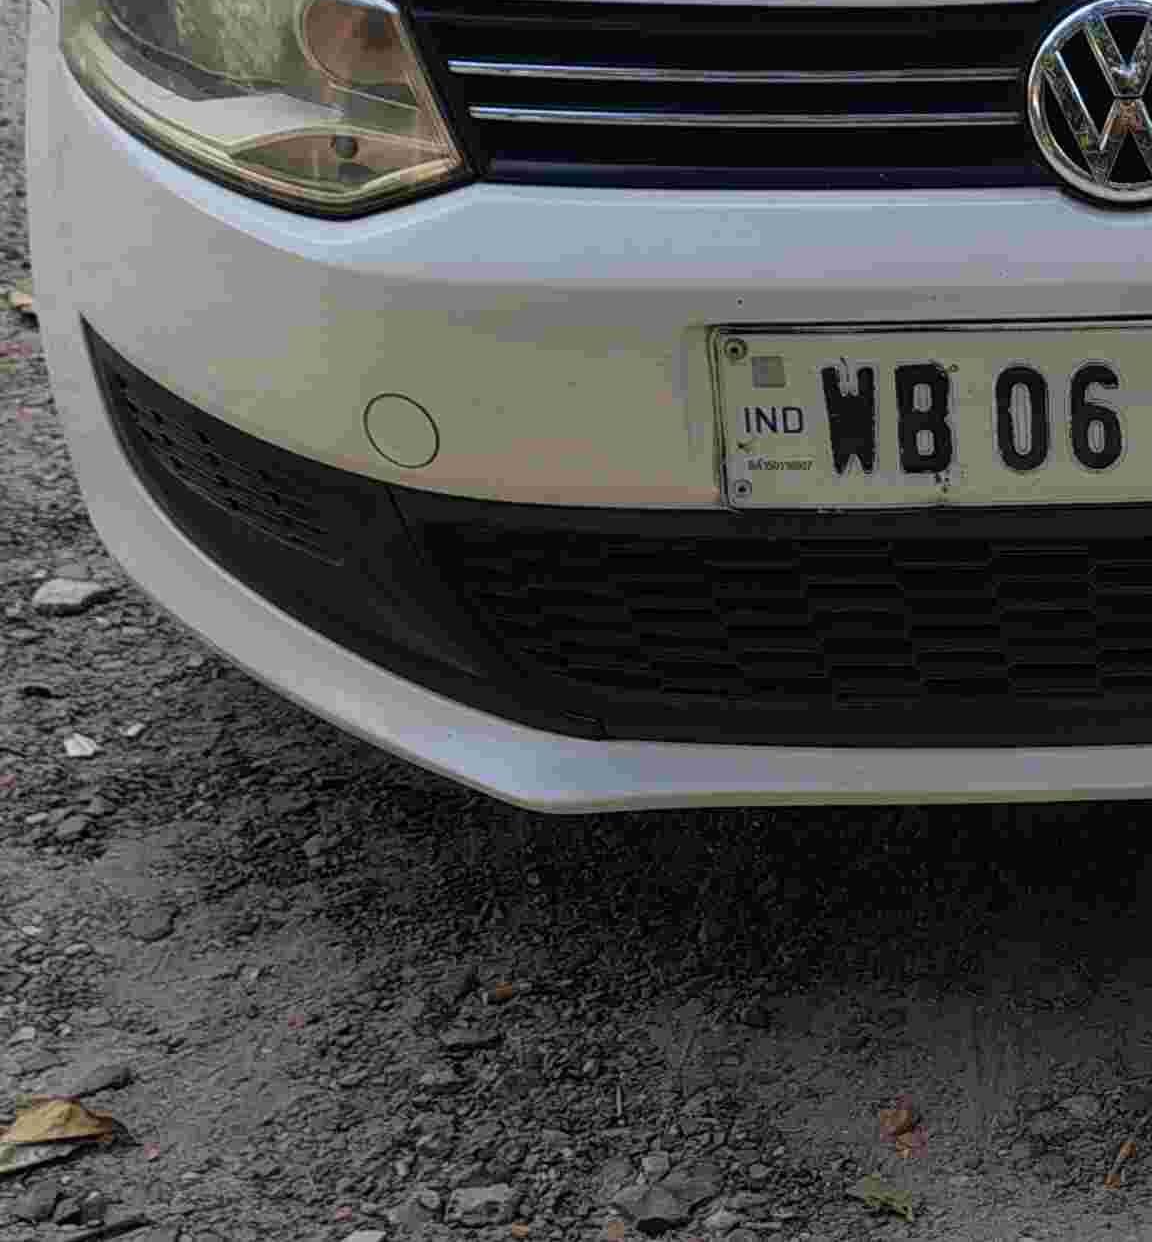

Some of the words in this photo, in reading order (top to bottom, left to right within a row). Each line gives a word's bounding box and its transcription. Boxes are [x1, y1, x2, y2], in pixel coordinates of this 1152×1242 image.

[743, 405, 804, 434] IND
[820, 361, 954, 475] WB
[994, 363, 1124, 471] 06
